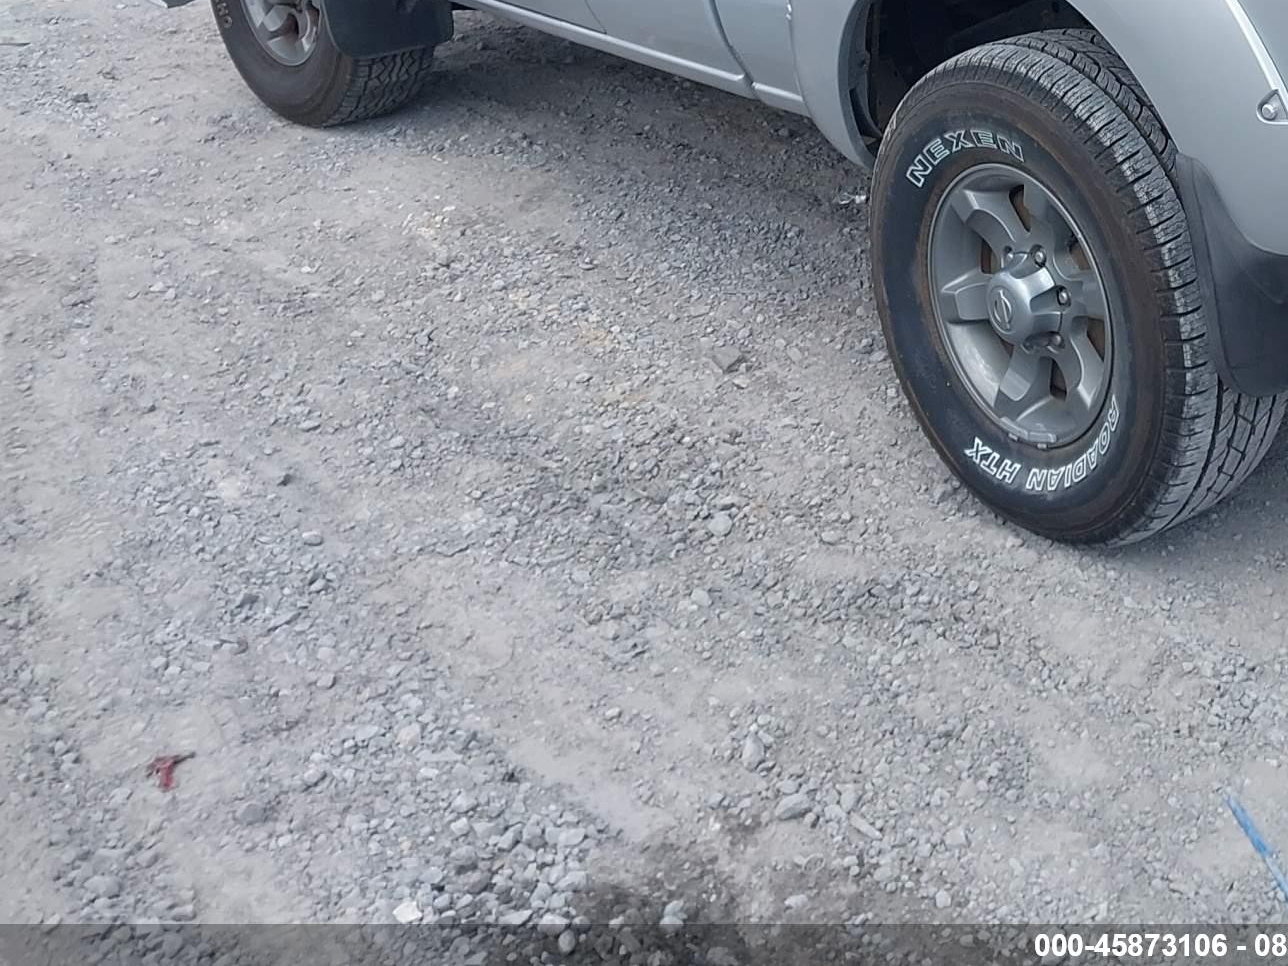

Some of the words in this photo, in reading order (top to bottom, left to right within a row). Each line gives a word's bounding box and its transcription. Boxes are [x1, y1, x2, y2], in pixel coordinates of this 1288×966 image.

[906, 130, 1024, 187] NEXEN
[964, 436, 1021, 484] HTX
[1025, 394, 1120, 491] ROADIAN
